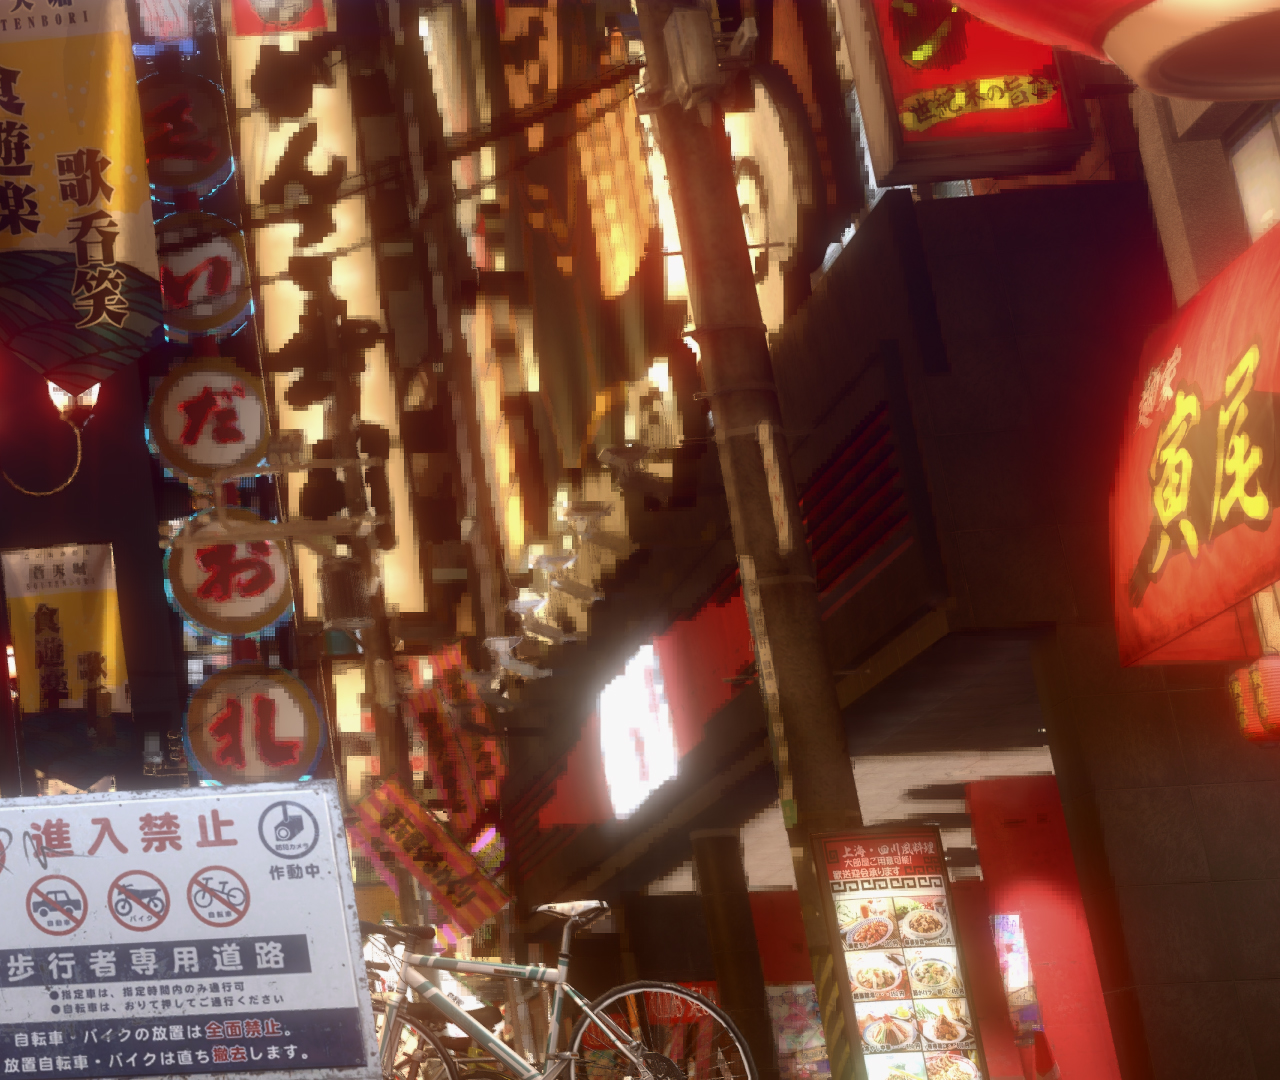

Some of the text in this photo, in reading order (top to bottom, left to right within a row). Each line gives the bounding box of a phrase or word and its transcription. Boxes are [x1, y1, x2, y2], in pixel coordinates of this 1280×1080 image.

[54, 146, 130, 332] 歌呑笑
[30, 808, 238, 859] 進入禁止
[269, 863, 320, 881] 作動中
[46, 918, 71, 927] 自動車
[129, 915, 153, 923] バイク
[208, 910, 232, 919] 自転車
[6, 940, 285, 983] 歩行者専用道路
[14, 1017, 292, 1048] 自転車・バイクの放置は全面禁止。
[3, 1044, 309, 1074] 放置自転車・バイクは直ち撤去します。
